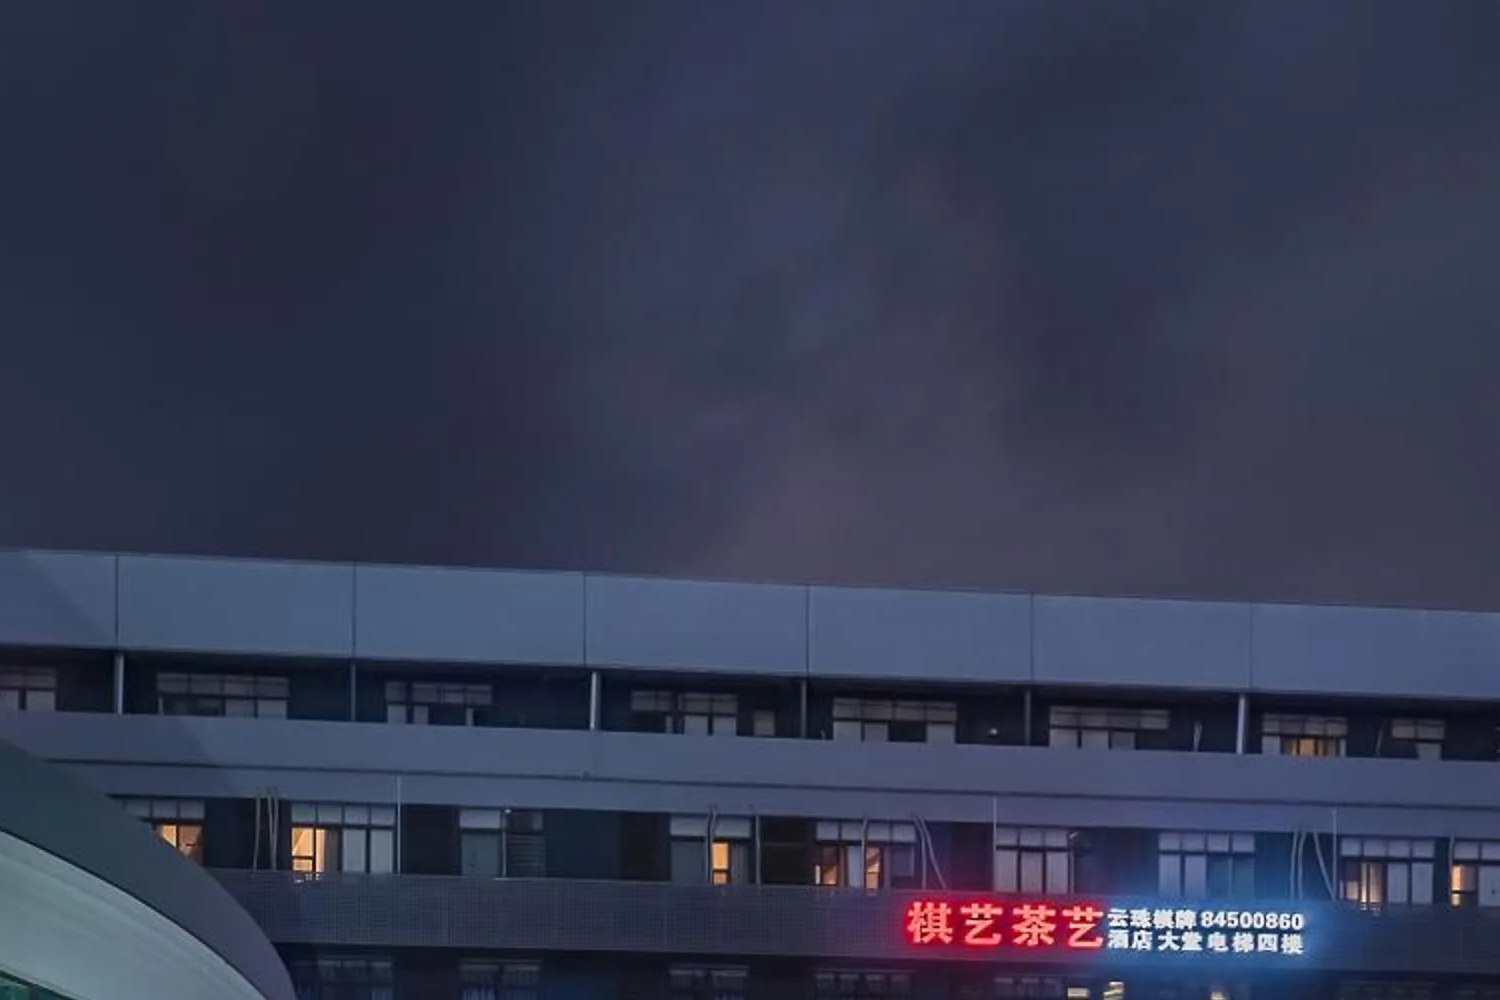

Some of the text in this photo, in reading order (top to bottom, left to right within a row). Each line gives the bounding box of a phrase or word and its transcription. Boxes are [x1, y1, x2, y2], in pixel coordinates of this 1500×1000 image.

[907, 900, 1104, 949] 棋艺茶艺
[1200, 910, 1304, 931] 84500860
